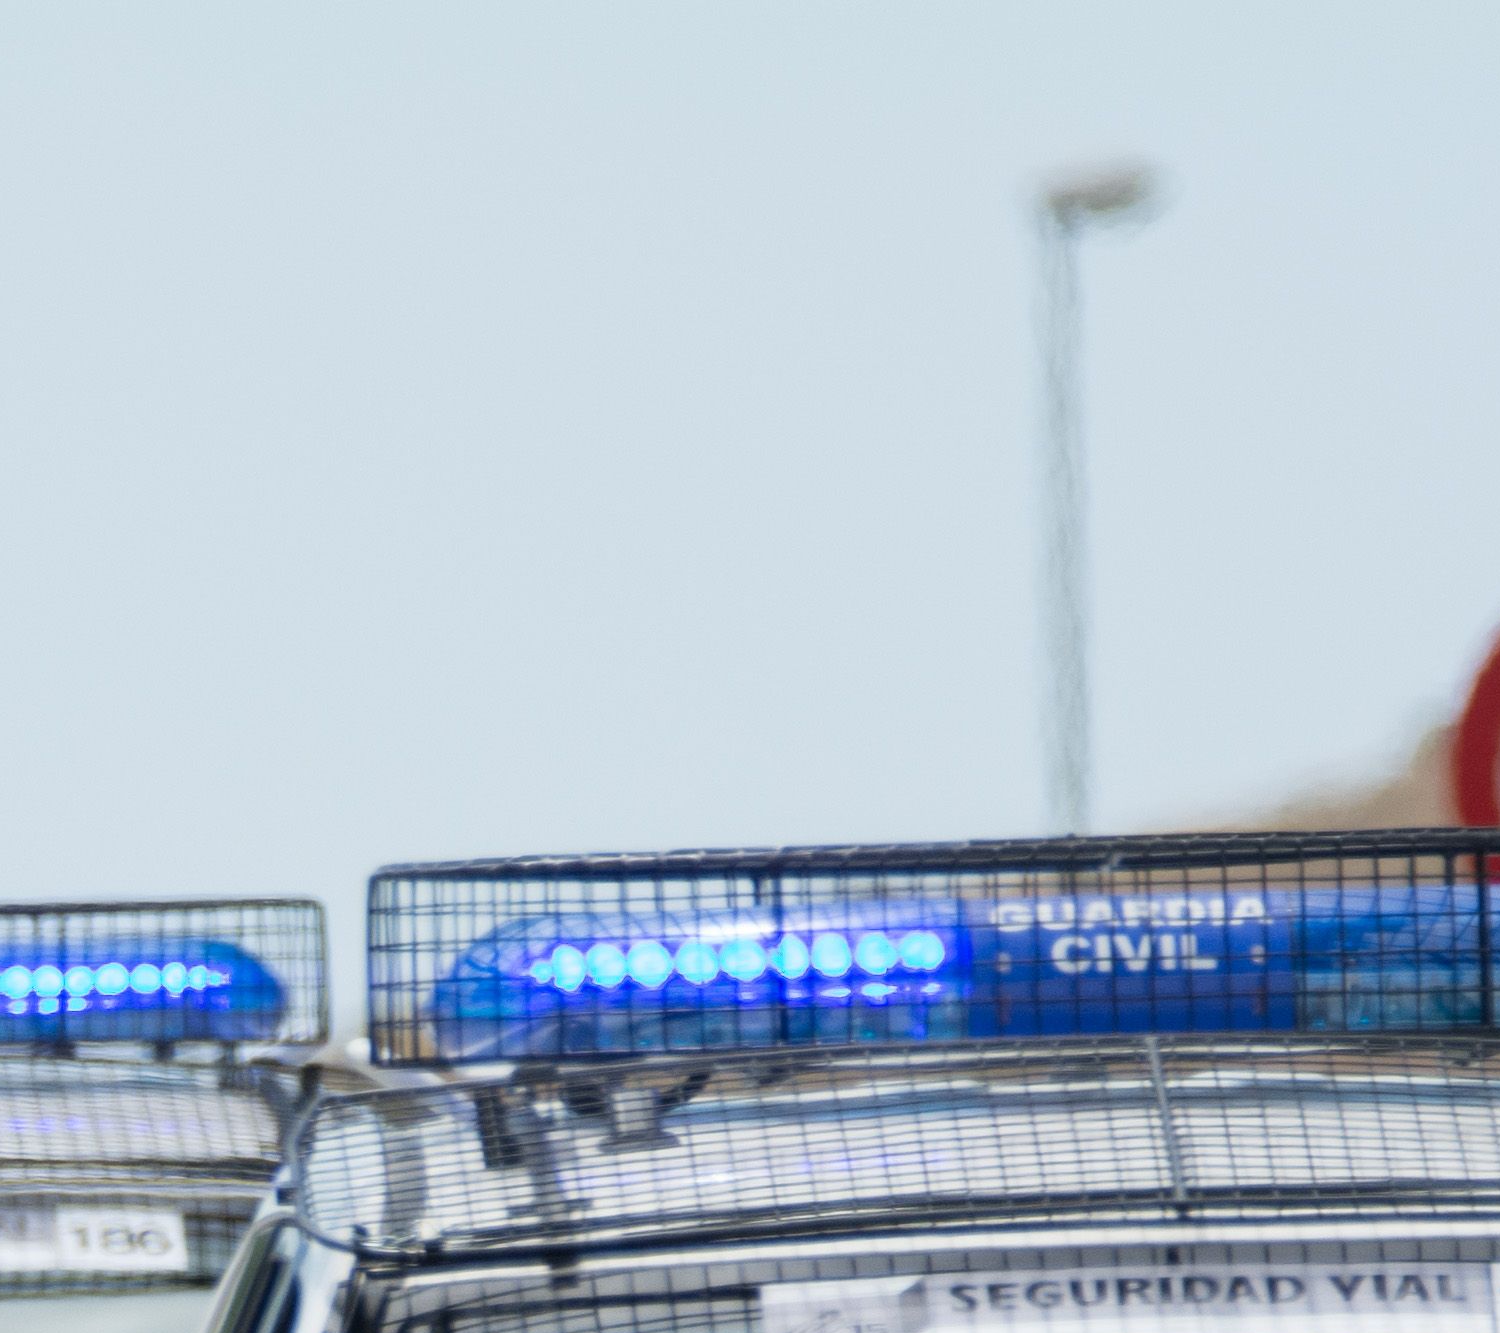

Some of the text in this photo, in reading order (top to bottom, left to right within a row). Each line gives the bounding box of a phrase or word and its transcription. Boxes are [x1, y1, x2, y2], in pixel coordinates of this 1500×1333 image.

[990, 897, 1273, 933] GUARDIA
[1051, 933, 1218, 975] CIVIL
[950, 1273, 1467, 1313] SEGURIDAD VIAL
